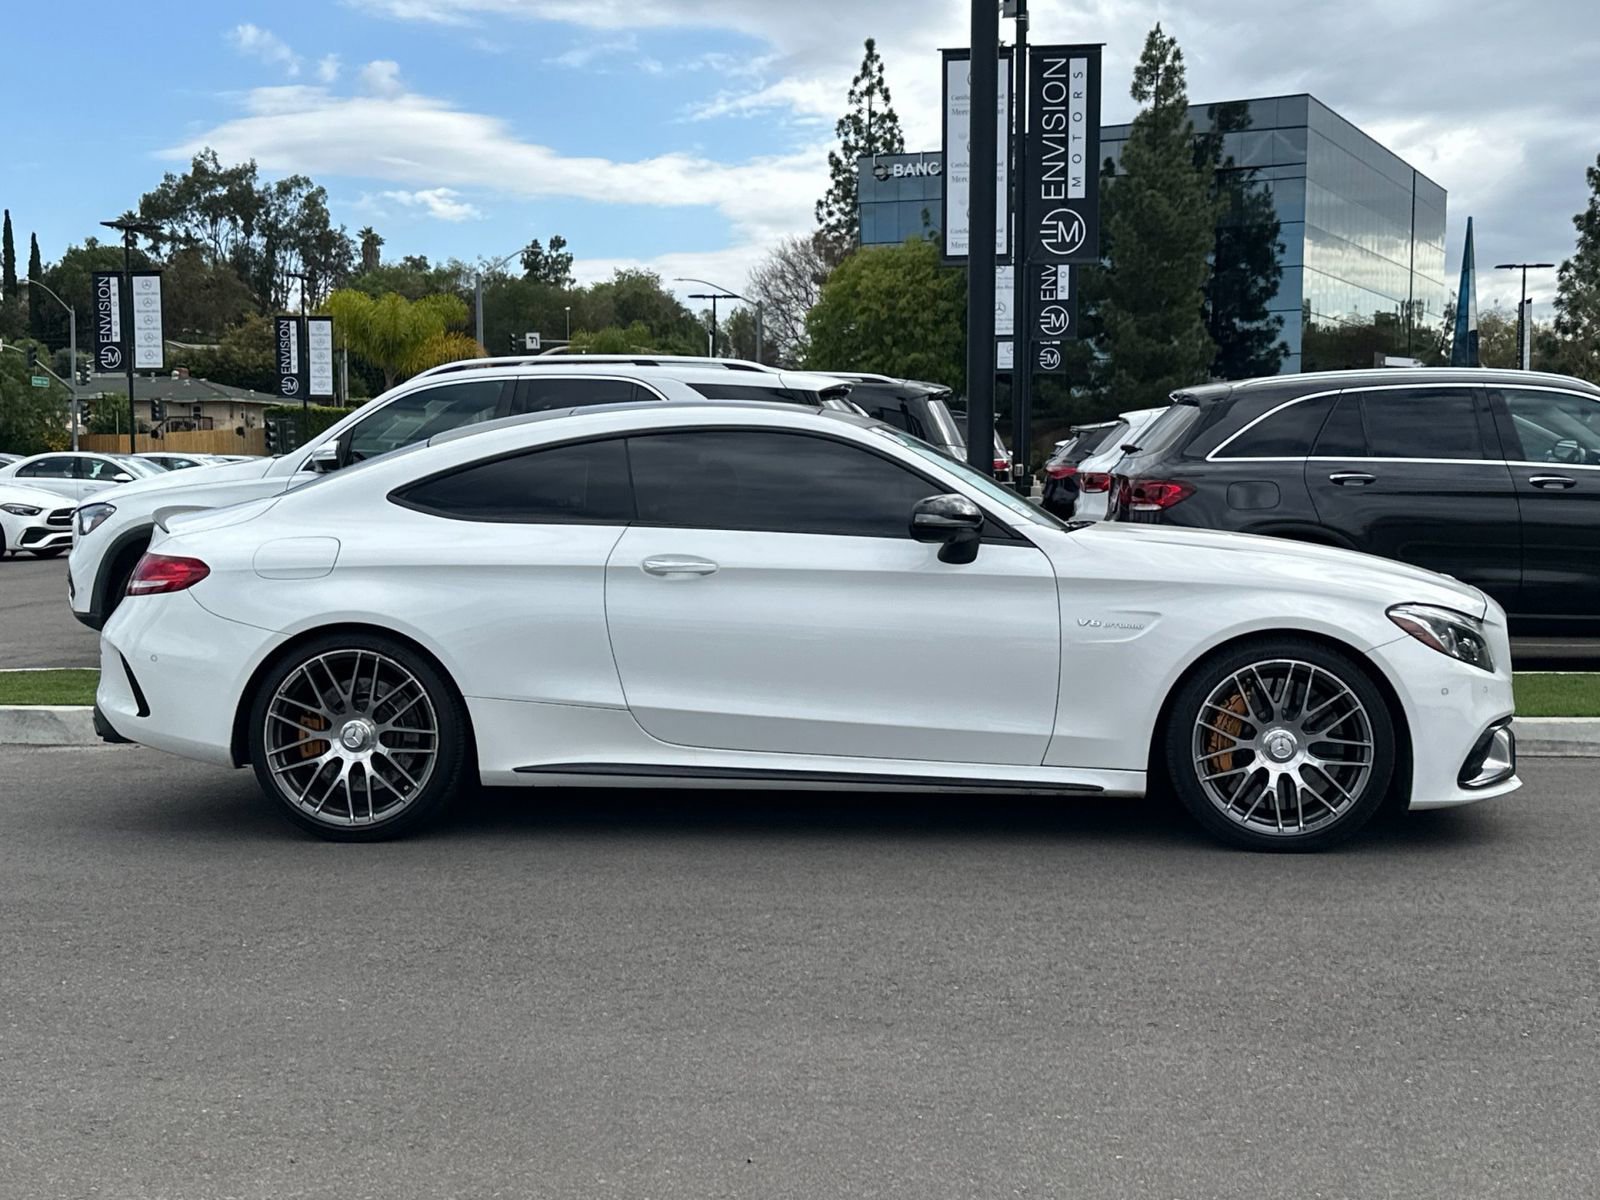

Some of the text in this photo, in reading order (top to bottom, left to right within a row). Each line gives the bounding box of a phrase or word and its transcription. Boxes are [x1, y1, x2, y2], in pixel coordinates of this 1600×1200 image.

[1041, 58, 1067, 199] ENVISION
[1072, 71, 1083, 188] MOTORS
[893, 161, 940, 177] BANC
[98, 276, 111, 343] ENVISION
[279, 320, 291, 374] ENVISION
